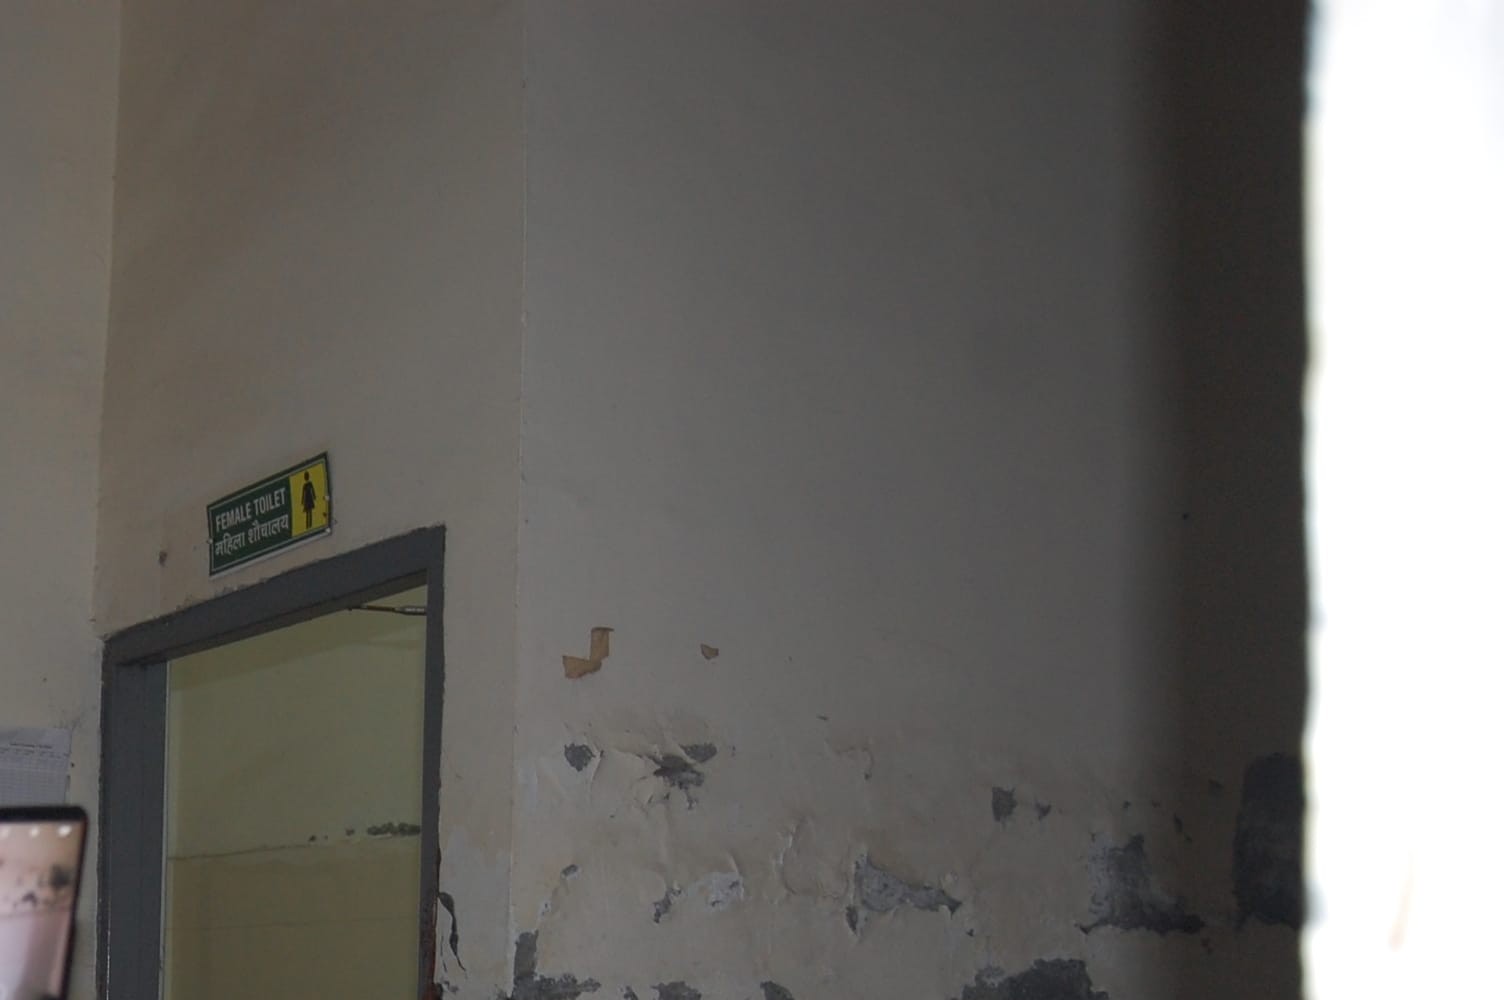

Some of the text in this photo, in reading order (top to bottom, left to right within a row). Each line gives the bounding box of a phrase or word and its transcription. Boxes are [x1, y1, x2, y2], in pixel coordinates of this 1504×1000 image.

[215, 487, 286, 532] FEMALE TOILET
[215, 513, 289, 556] महिला शौचालय
